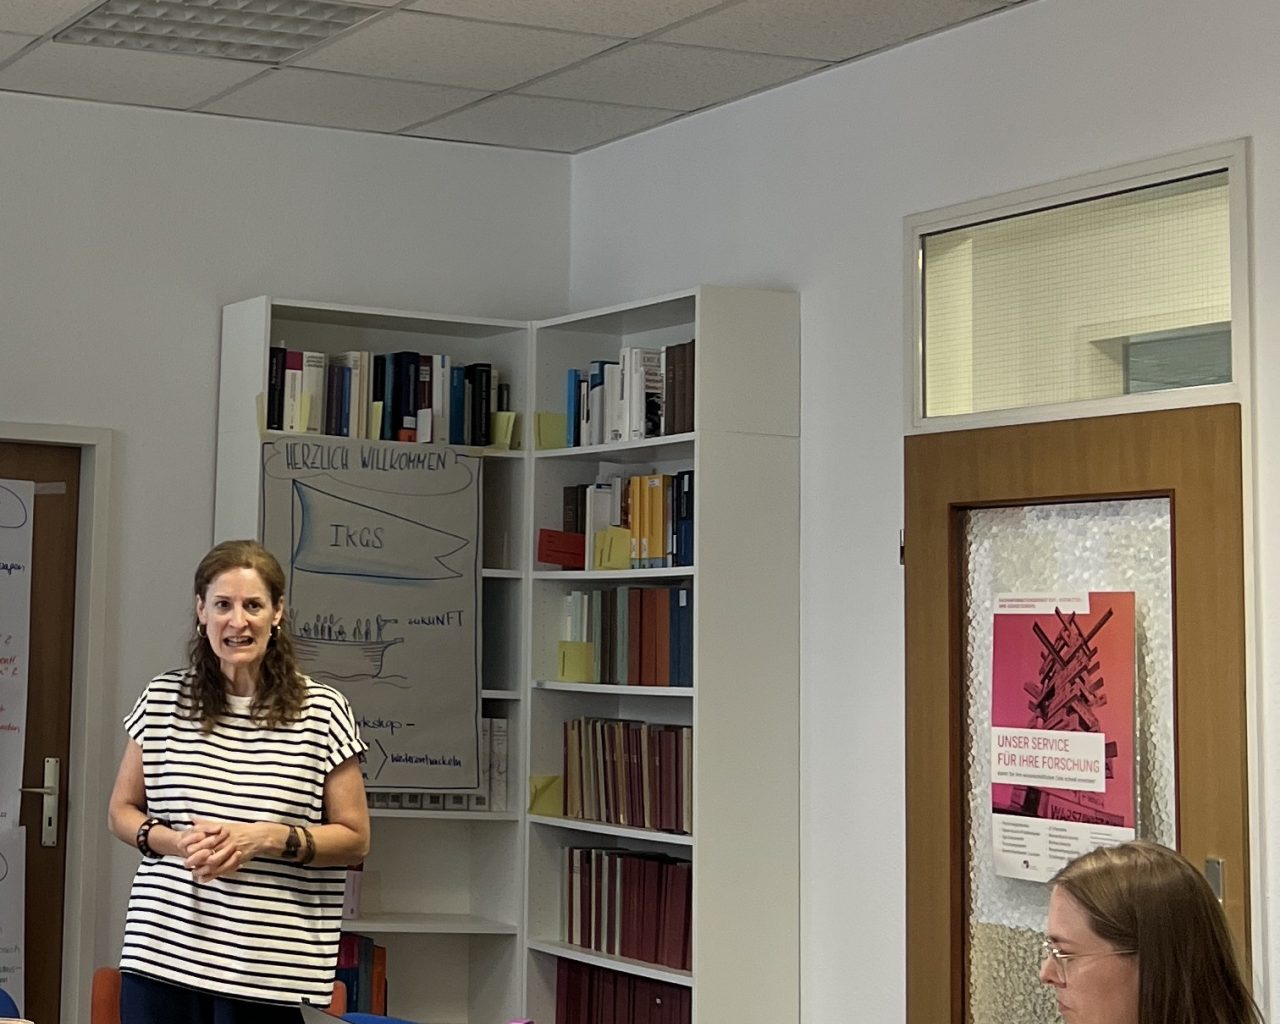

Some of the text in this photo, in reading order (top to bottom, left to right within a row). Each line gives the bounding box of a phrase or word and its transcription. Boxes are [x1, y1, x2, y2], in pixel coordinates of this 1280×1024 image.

[285, 443, 449, 473] HERZLICH WILLKOMMEN
[330, 524, 384, 549] IKGS
[998, 735, 1070, 753] UNSER SERVICE
[998, 751, 1100, 773] FÜR IHRE FORSCHUNG
